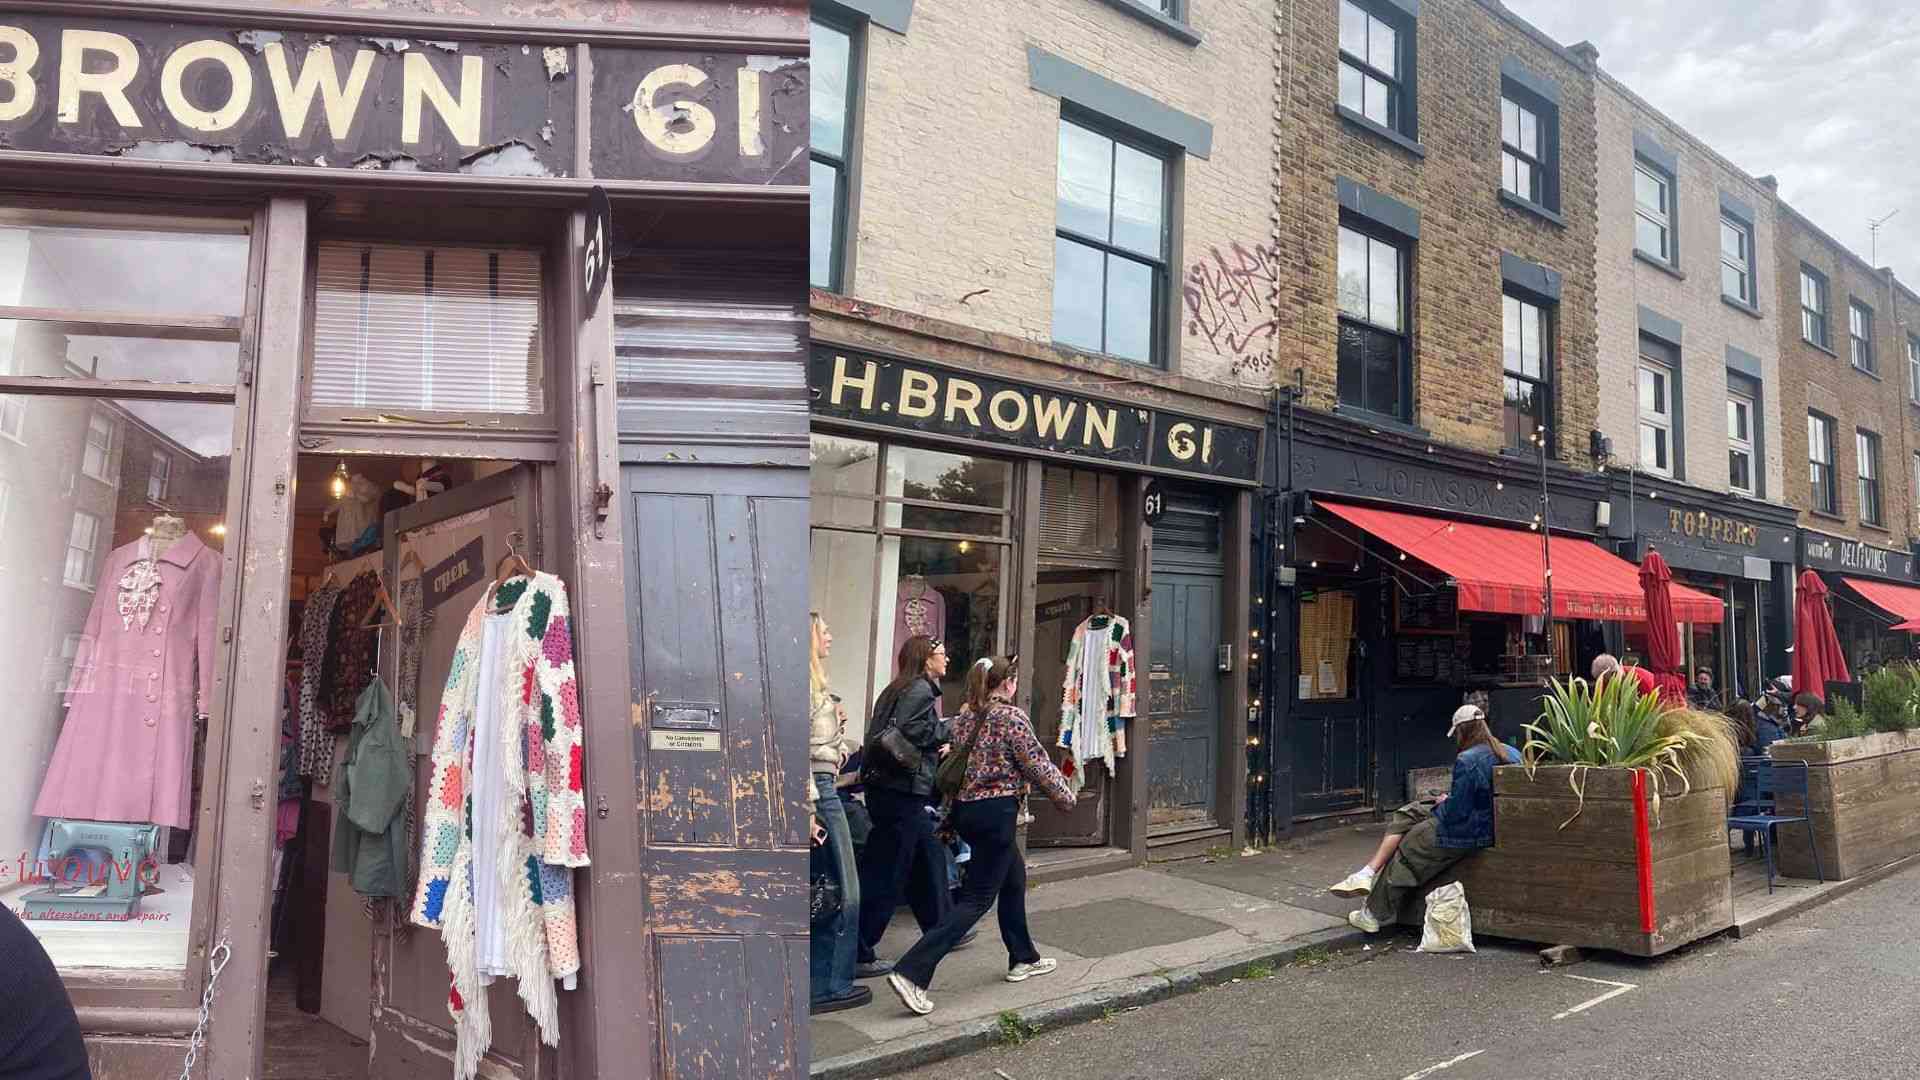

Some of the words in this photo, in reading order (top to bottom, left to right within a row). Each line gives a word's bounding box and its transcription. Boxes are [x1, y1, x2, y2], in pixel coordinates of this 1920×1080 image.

[633, 63, 766, 157] 61
[585, 215, 604, 293] 61
[1167, 422, 1214, 464] 61
[1145, 493, 1161, 517] 61
